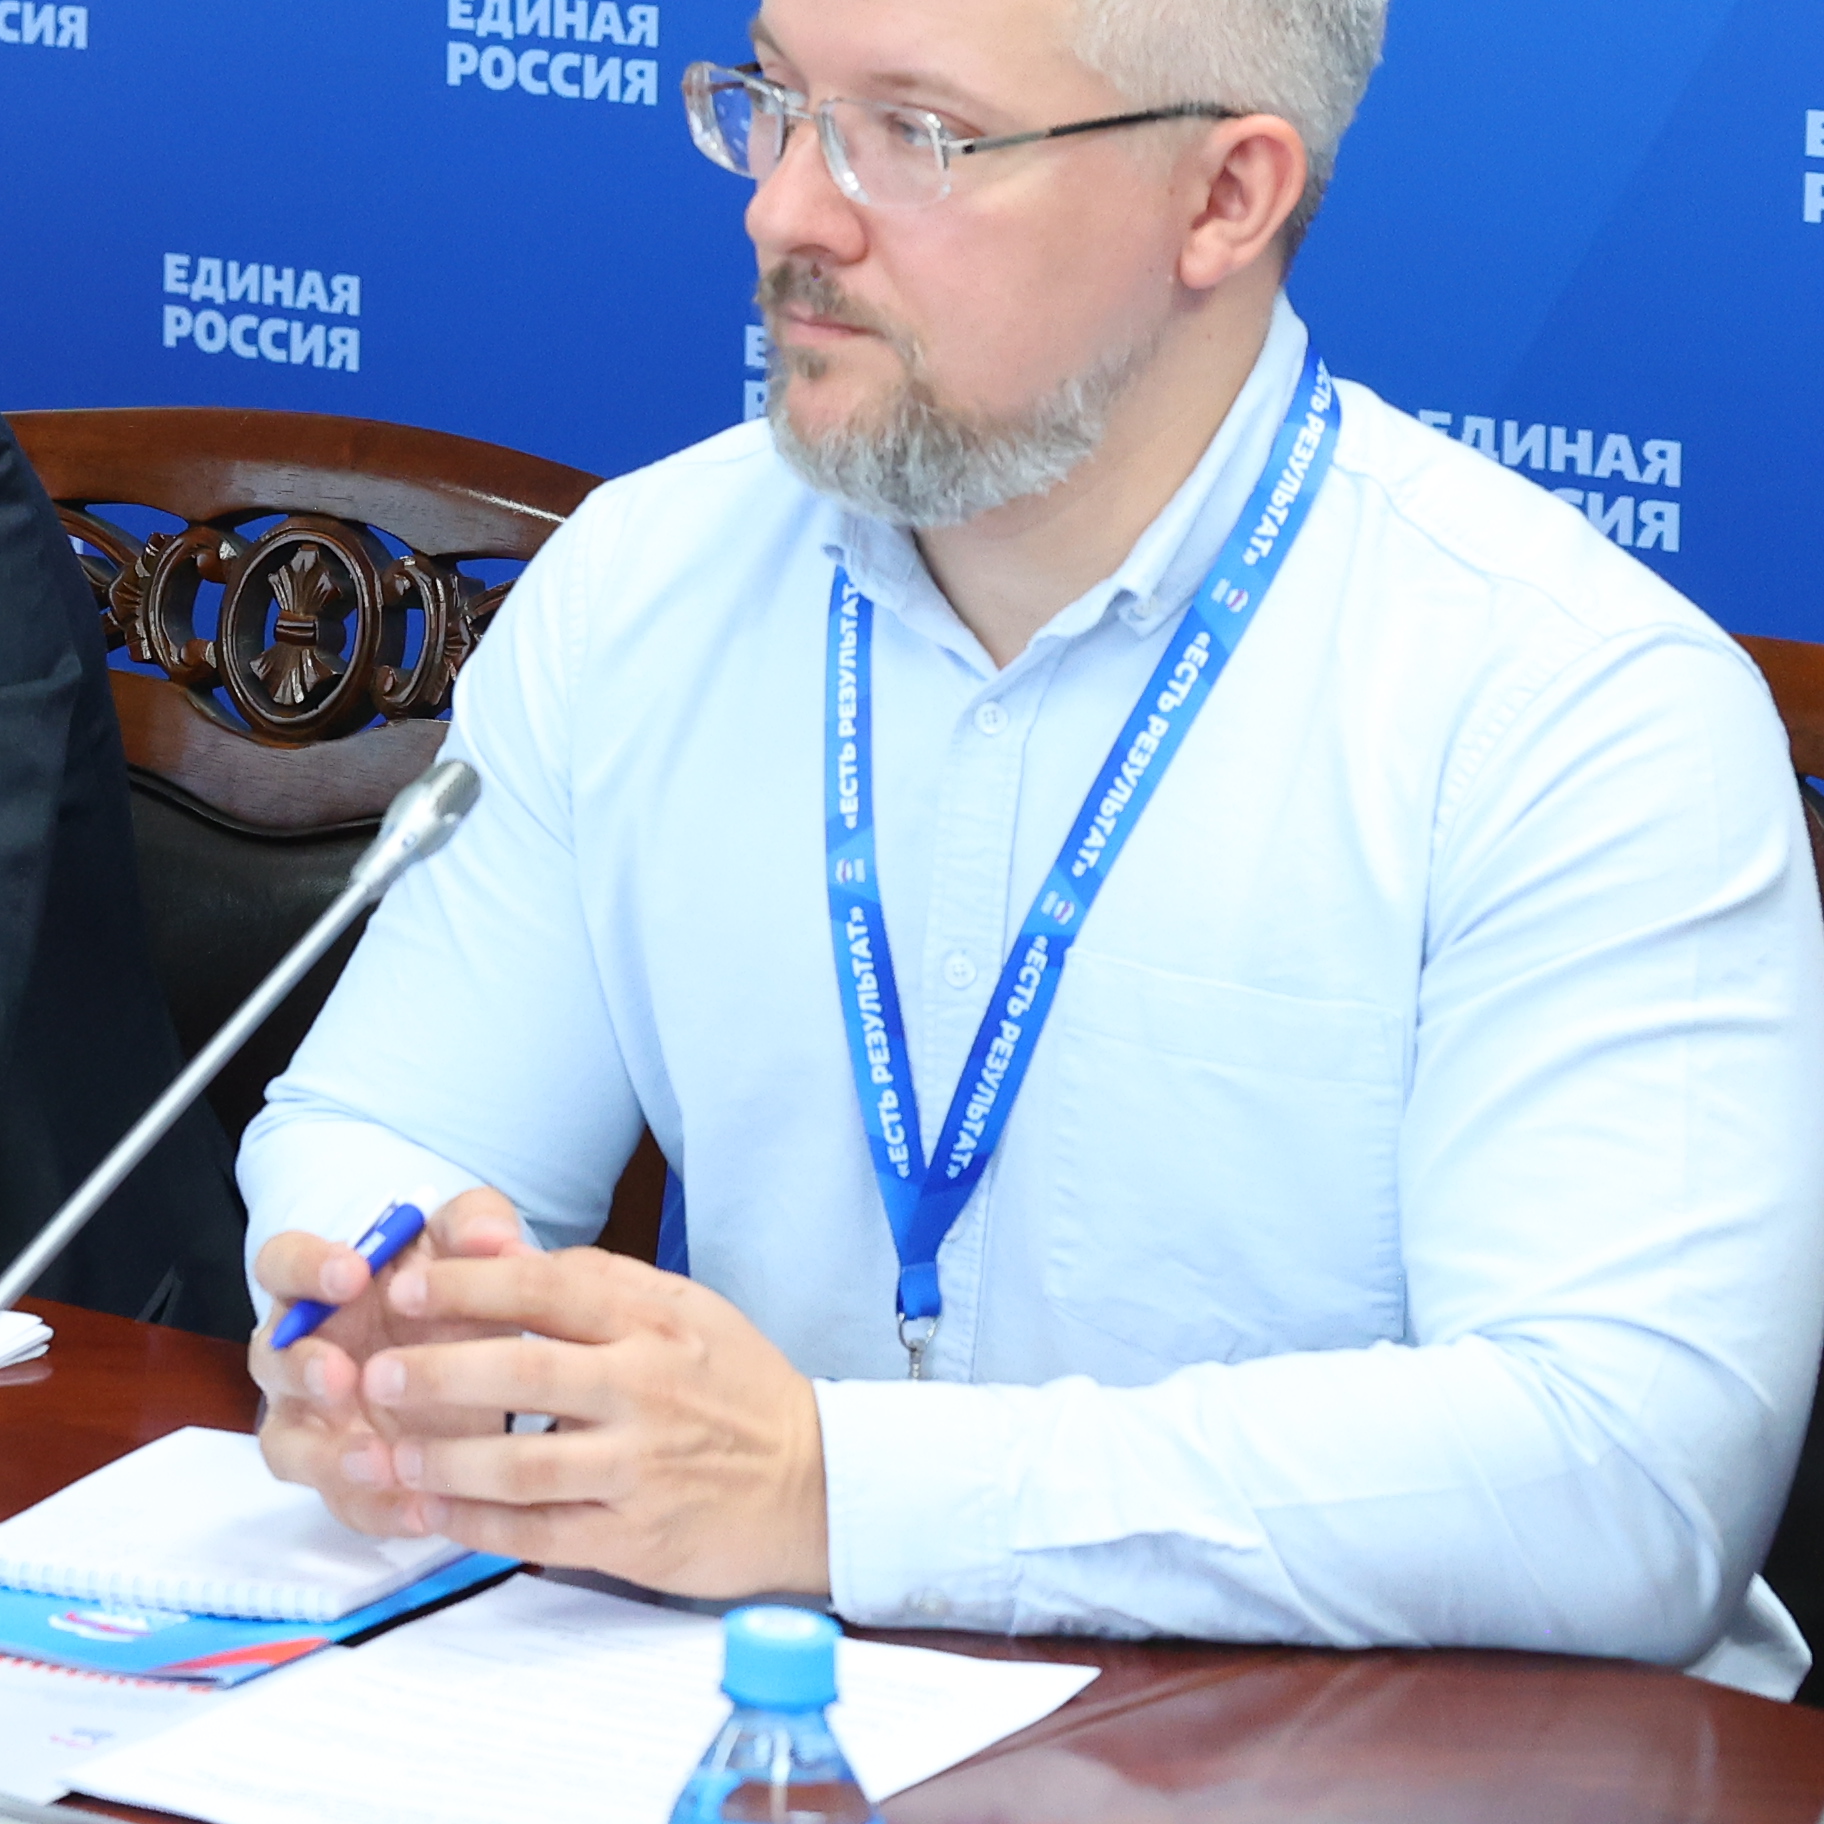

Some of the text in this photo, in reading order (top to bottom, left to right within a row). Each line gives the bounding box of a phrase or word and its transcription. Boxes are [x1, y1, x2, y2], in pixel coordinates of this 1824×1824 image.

[445, 41, 658, 105] РОССИЯ
[163, 253, 361, 316] ЕДИНАЯ
[163, 305, 360, 372] РОССИЯ
[1242, 411, 1327, 566] РЕЗУЛЬТАТ»
[837, 583, 860, 830] «ЕСТЬ РЕЗУЛЬТАТ
[1071, 631, 1211, 878] «ЕСТЬ РЕЗУЛЬТАТ»
[845, 905, 911, 1180] «ЕСТЬ РЕЗУЛЬТАТ»
[944, 934, 1049, 1181] «ЕСТЬ РЕЗУЛЬТАТ»
